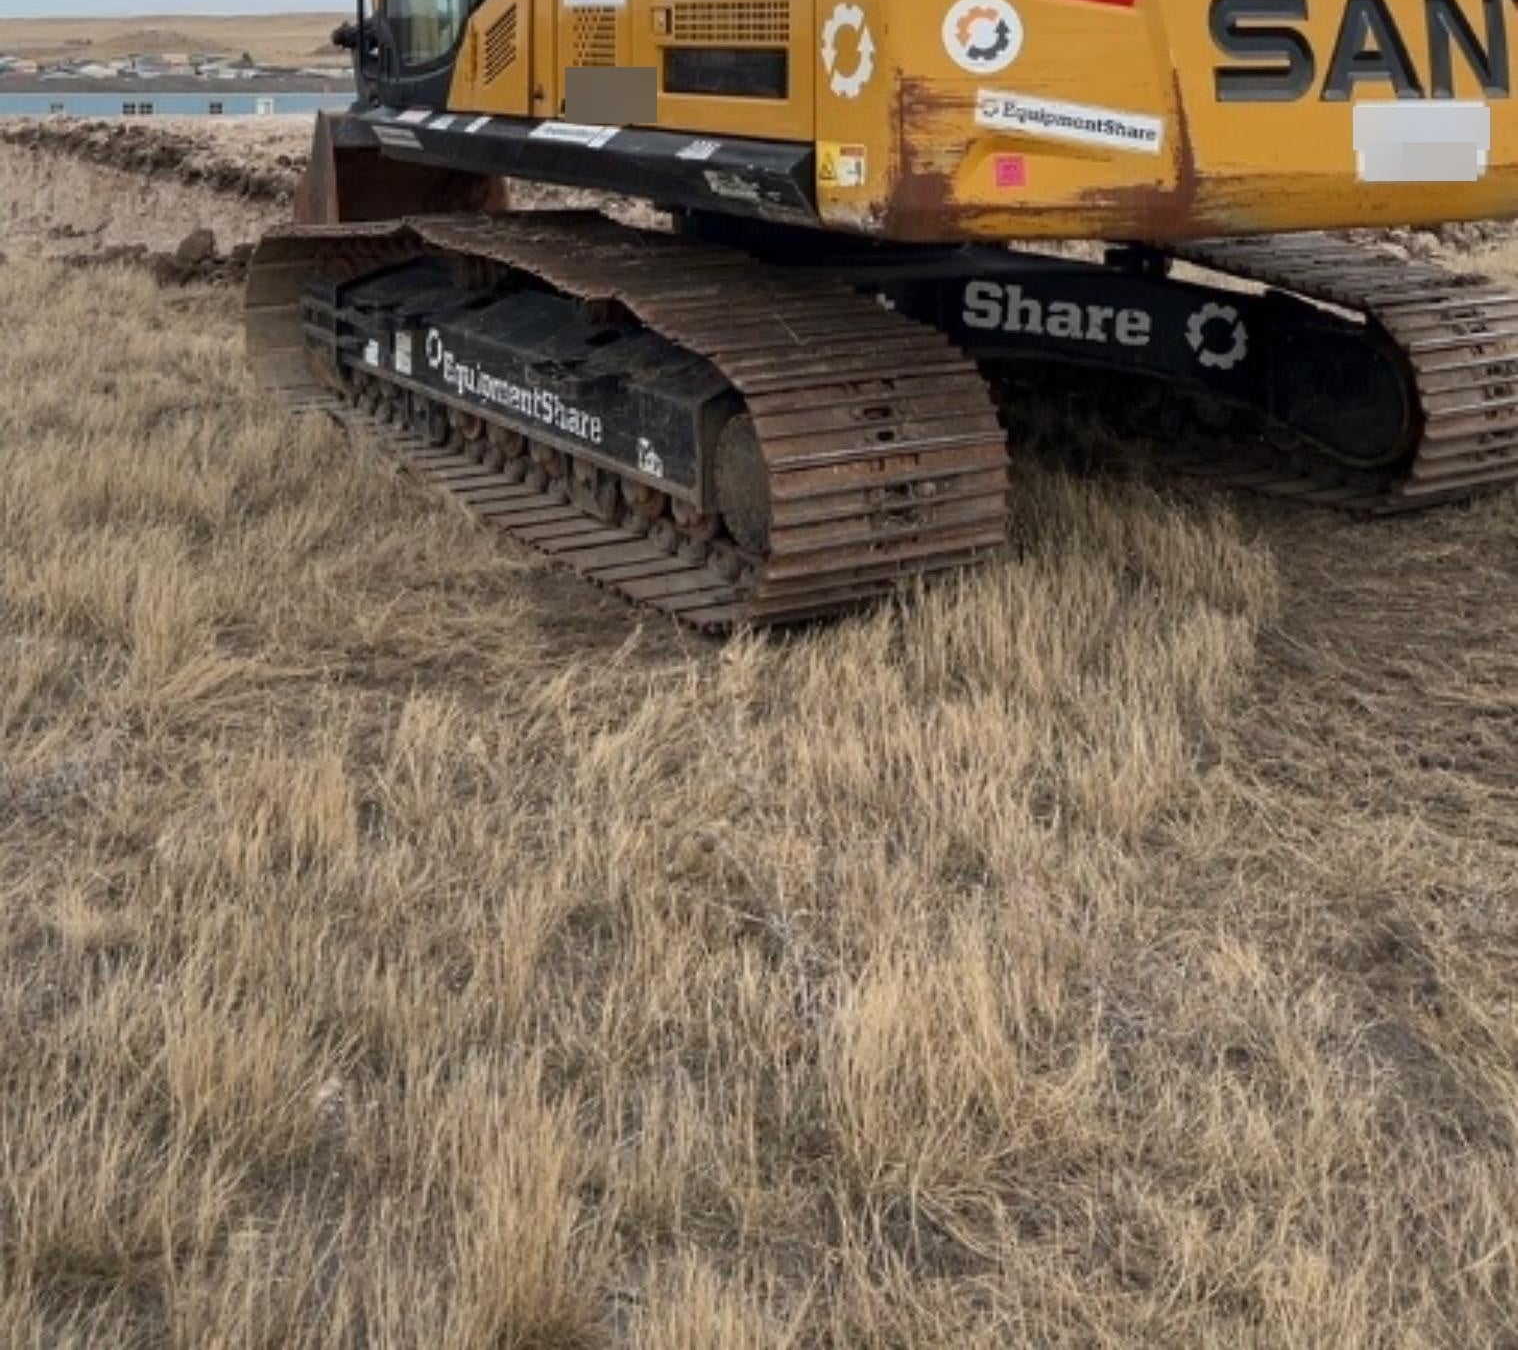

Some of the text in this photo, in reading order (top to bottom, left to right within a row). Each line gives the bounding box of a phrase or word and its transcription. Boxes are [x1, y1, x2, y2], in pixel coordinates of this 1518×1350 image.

[1002, 101, 1157, 142] EquipmentShare
[962, 280, 1152, 347] Share
[443, 350, 603, 443] EquipmentShare
